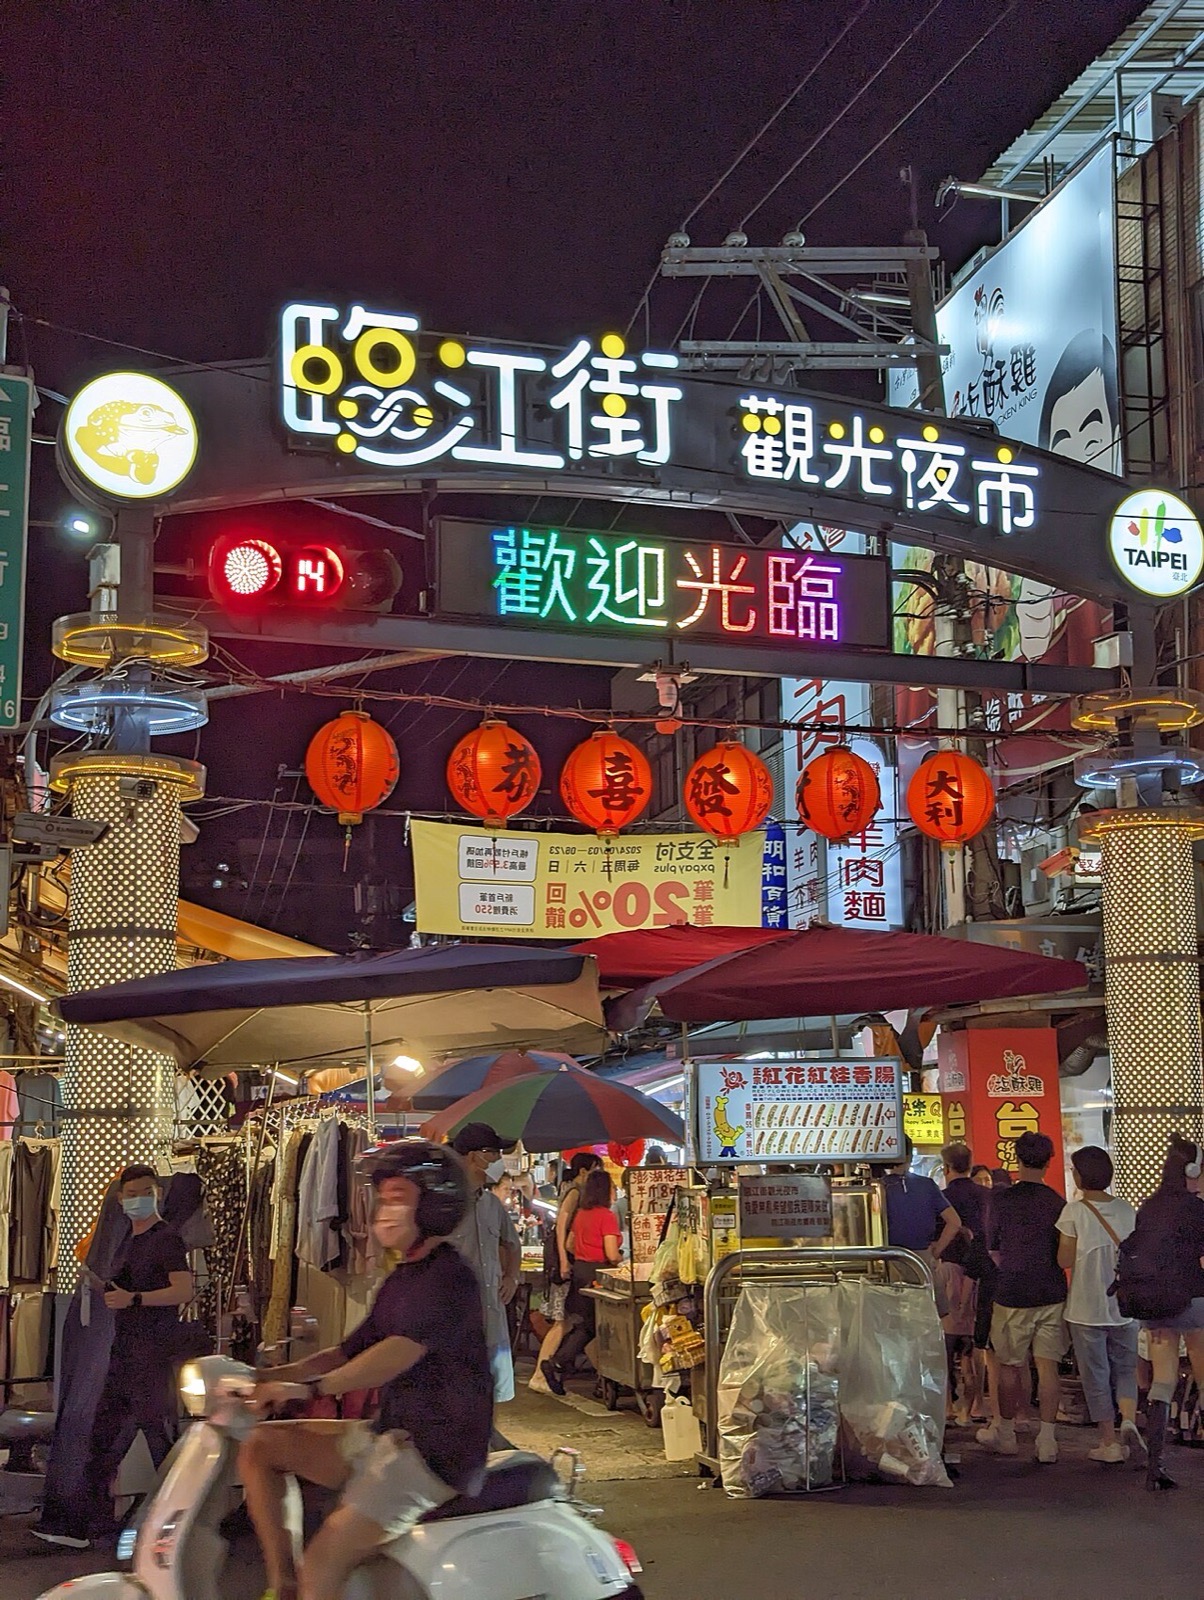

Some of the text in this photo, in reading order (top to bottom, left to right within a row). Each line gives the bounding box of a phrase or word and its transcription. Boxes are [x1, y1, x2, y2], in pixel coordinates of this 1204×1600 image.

[282, 303, 1040, 534] 臨江街 觀光夜市
[1018, 388, 1037, 410] KING
[298, 558, 325, 592] 14
[493, 528, 842, 642] 歡迎光臨
[1123, 547, 1188, 571] TAIPEI
[492, 743, 534, 803] 恭
[587, 751, 645, 811] 喜
[690, 762, 741, 817] 發
[924, 769, 964, 827] 大利
[761, 840, 788, 926] 明和百貨
[843, 801, 887, 922] 羊肉麵
